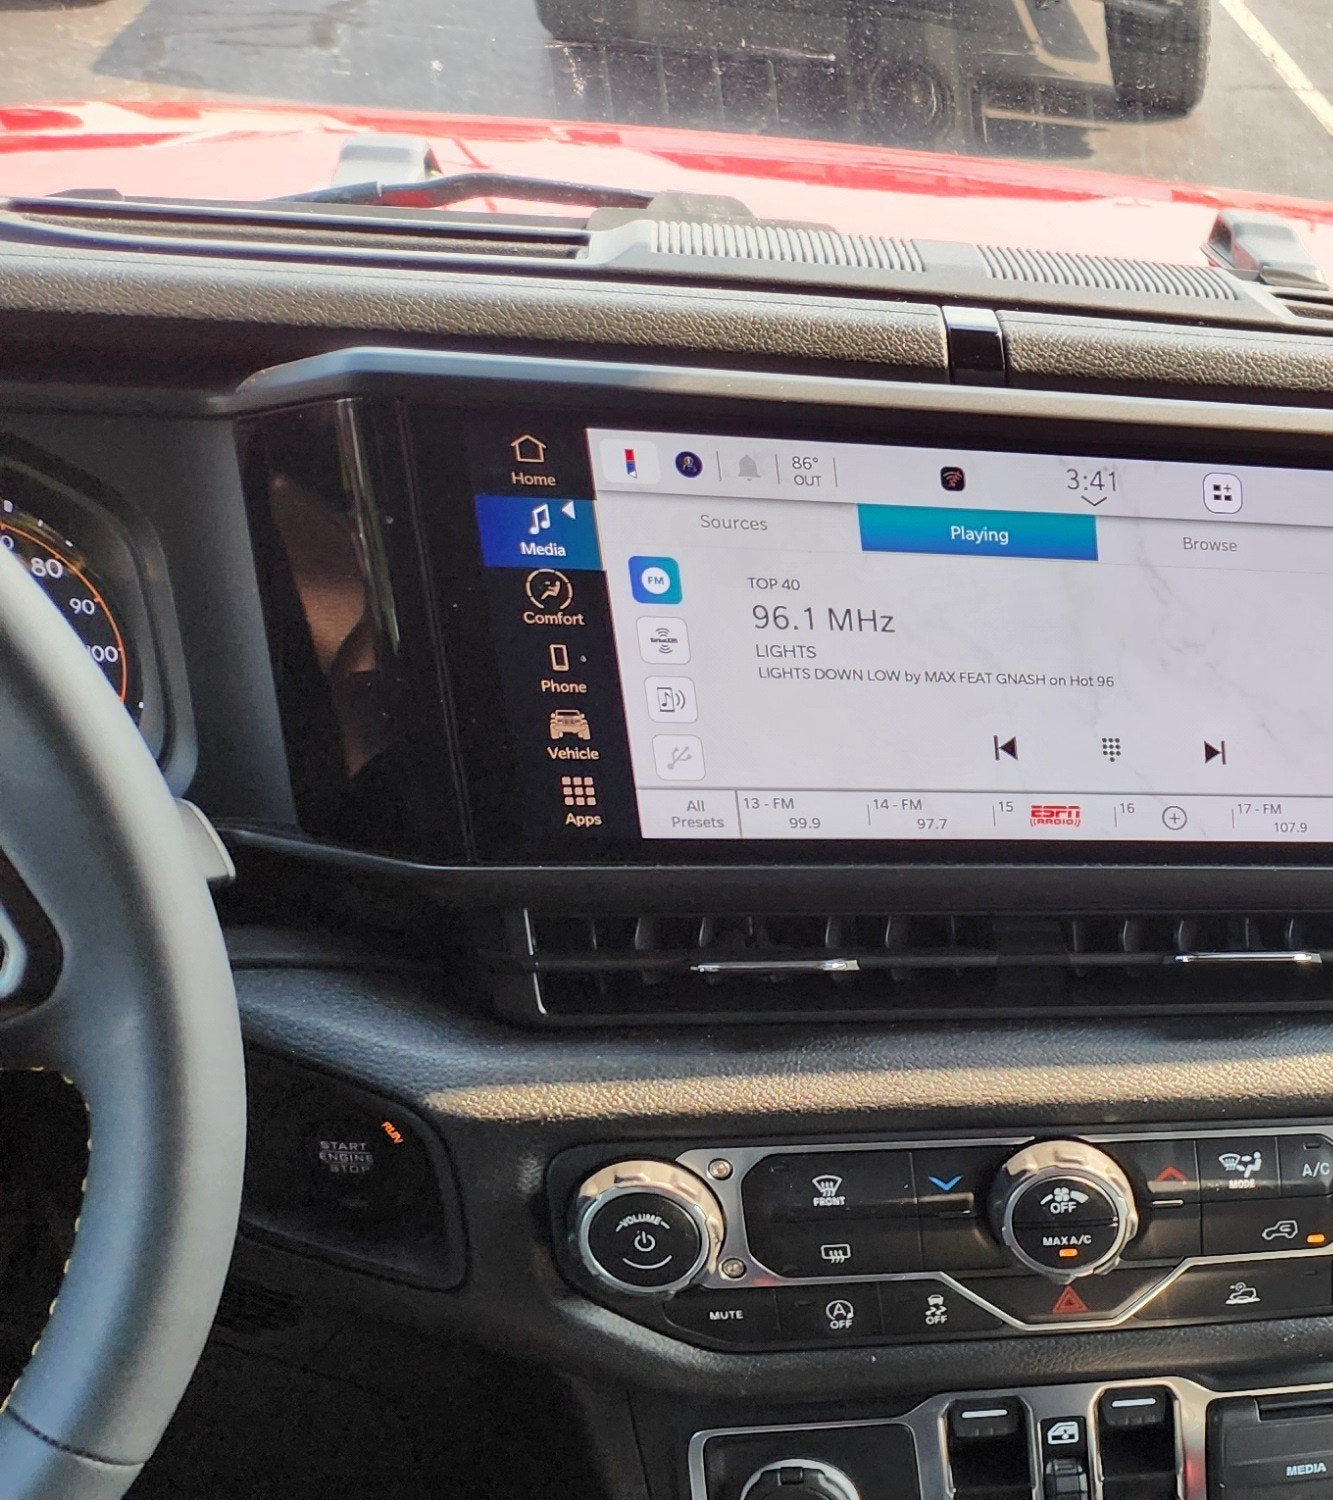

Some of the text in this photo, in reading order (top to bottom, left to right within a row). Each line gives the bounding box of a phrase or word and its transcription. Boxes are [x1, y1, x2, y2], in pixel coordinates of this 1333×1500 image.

[511, 472, 557, 487] Home
[793, 474, 822, 487] OUT
[1066, 468, 1117, 493] 3:41
[700, 514, 768, 531] Sources
[950, 526, 1009, 545] Playing
[520, 542, 566, 557] Media
[1183, 537, 1238, 553] Browse
[30, 557, 63, 578] 80
[647, 575, 664, 585] FM
[748, 577, 800, 591] TOP 40
[69, 598, 95, 615] 90
[523, 611, 585, 626] Comfort
[752, 604, 895, 633] 96.1 MHz
[85, 644, 118, 662] 00
[756, 644, 817, 659] LIGHTS
[758, 667, 1114, 687] LIGHTS DOWN LOW by MAX FEAT GNASH on Hot 96
[541, 679, 587, 693] Phone
[548, 746, 599, 761] Vehicle
[687, 800, 705, 812] All
[744, 798, 760, 809] 13
[773, 798, 794, 810] FM
[873, 799, 889, 810] 14
[902, 799, 922, 811] FM
[999, 801, 1014, 812] 15
[1120, 803, 1135, 814] 16
[1237, 804, 1251, 815] 17
[1264, 804, 1282, 815] FM
[1031, 805, 1080, 818] ESPN
[565, 813, 602, 828] Apps
[672, 816, 724, 829] Presets
[789, 817, 821, 829] 99.9
[917, 818, 947, 830] 97.7
[1274, 822, 1308, 833] 107.9
[381, 1121, 404, 1144] RUN
[320, 1141, 367, 1150] START
[319, 1152, 374, 1162] ENGINE
[1302, 1162, 1330, 1177] A/C
[1229, 1179, 1255, 1189] MODE
[813, 1196, 846, 1207] FRONT
[1050, 1201, 1077, 1214] OFF
[620, 1213, 662, 1227] VOLUME
[1042, 1234, 1092, 1246] MAX A/C
[709, 1310, 744, 1321] MUTE
[925, 1315, 948, 1326] OFF
[830, 1319, 853, 1330] OFF
[1286, 1462, 1327, 1477] MEDIA
